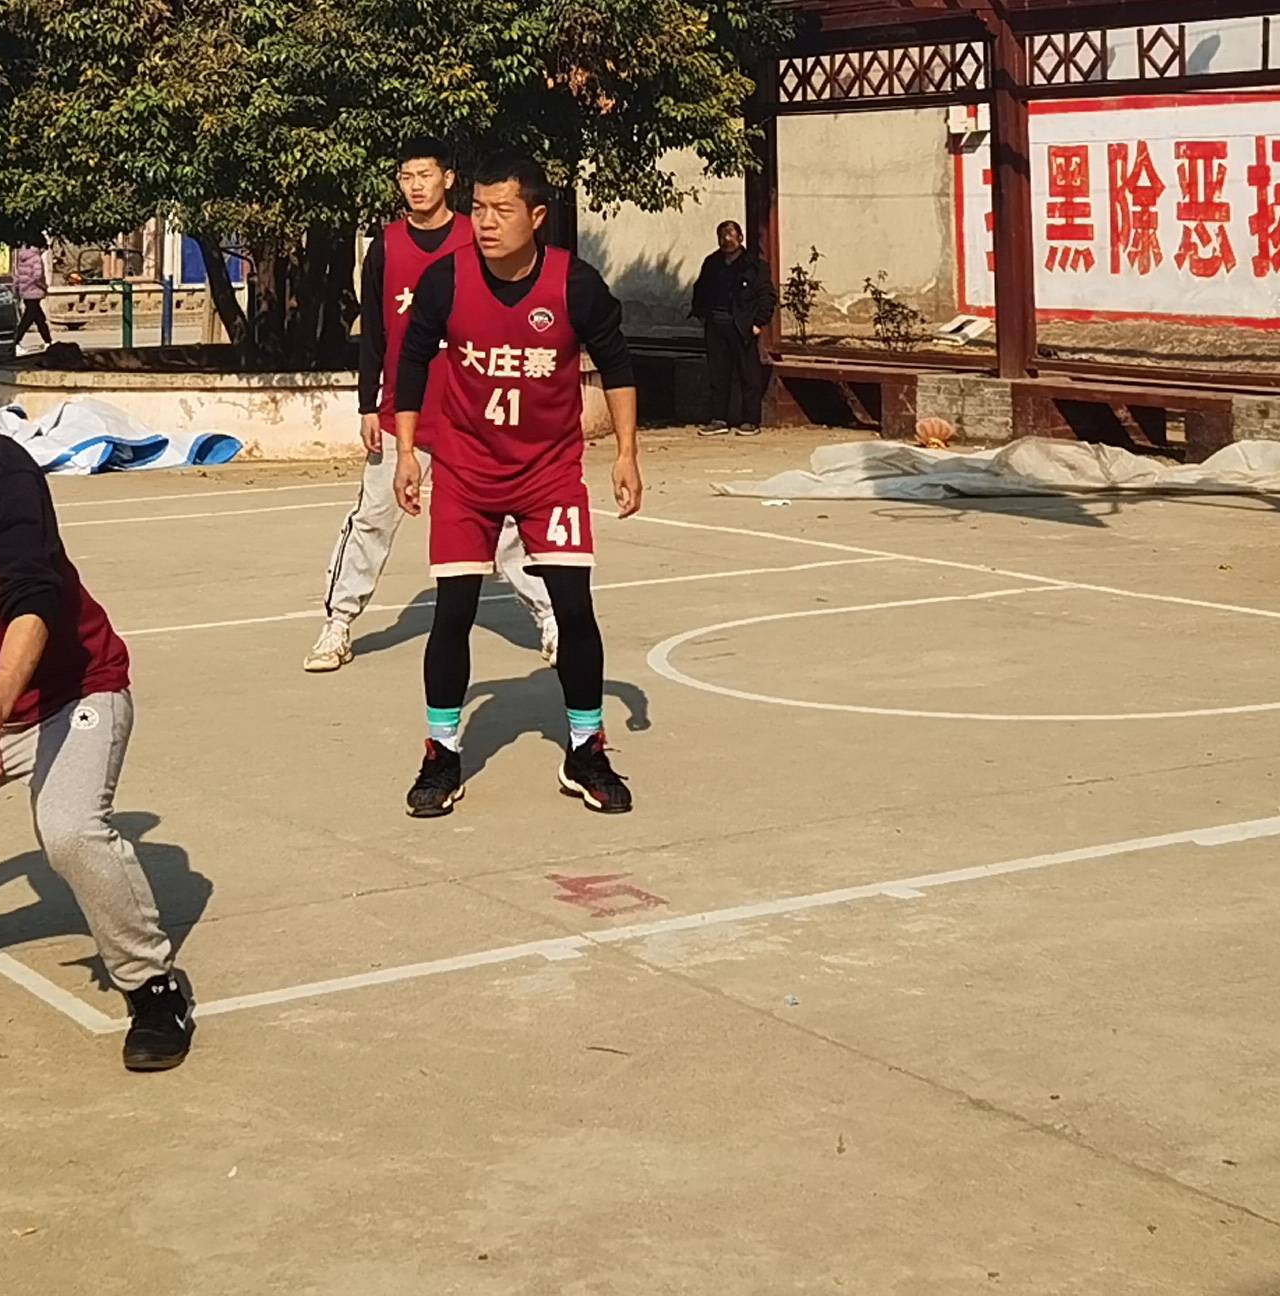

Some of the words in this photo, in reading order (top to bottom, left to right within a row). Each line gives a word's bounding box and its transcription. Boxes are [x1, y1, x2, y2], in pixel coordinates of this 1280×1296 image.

[458, 341, 557, 379] 大庄寨
[484, 388, 521, 426] 41
[546, 506, 581, 546] 41
